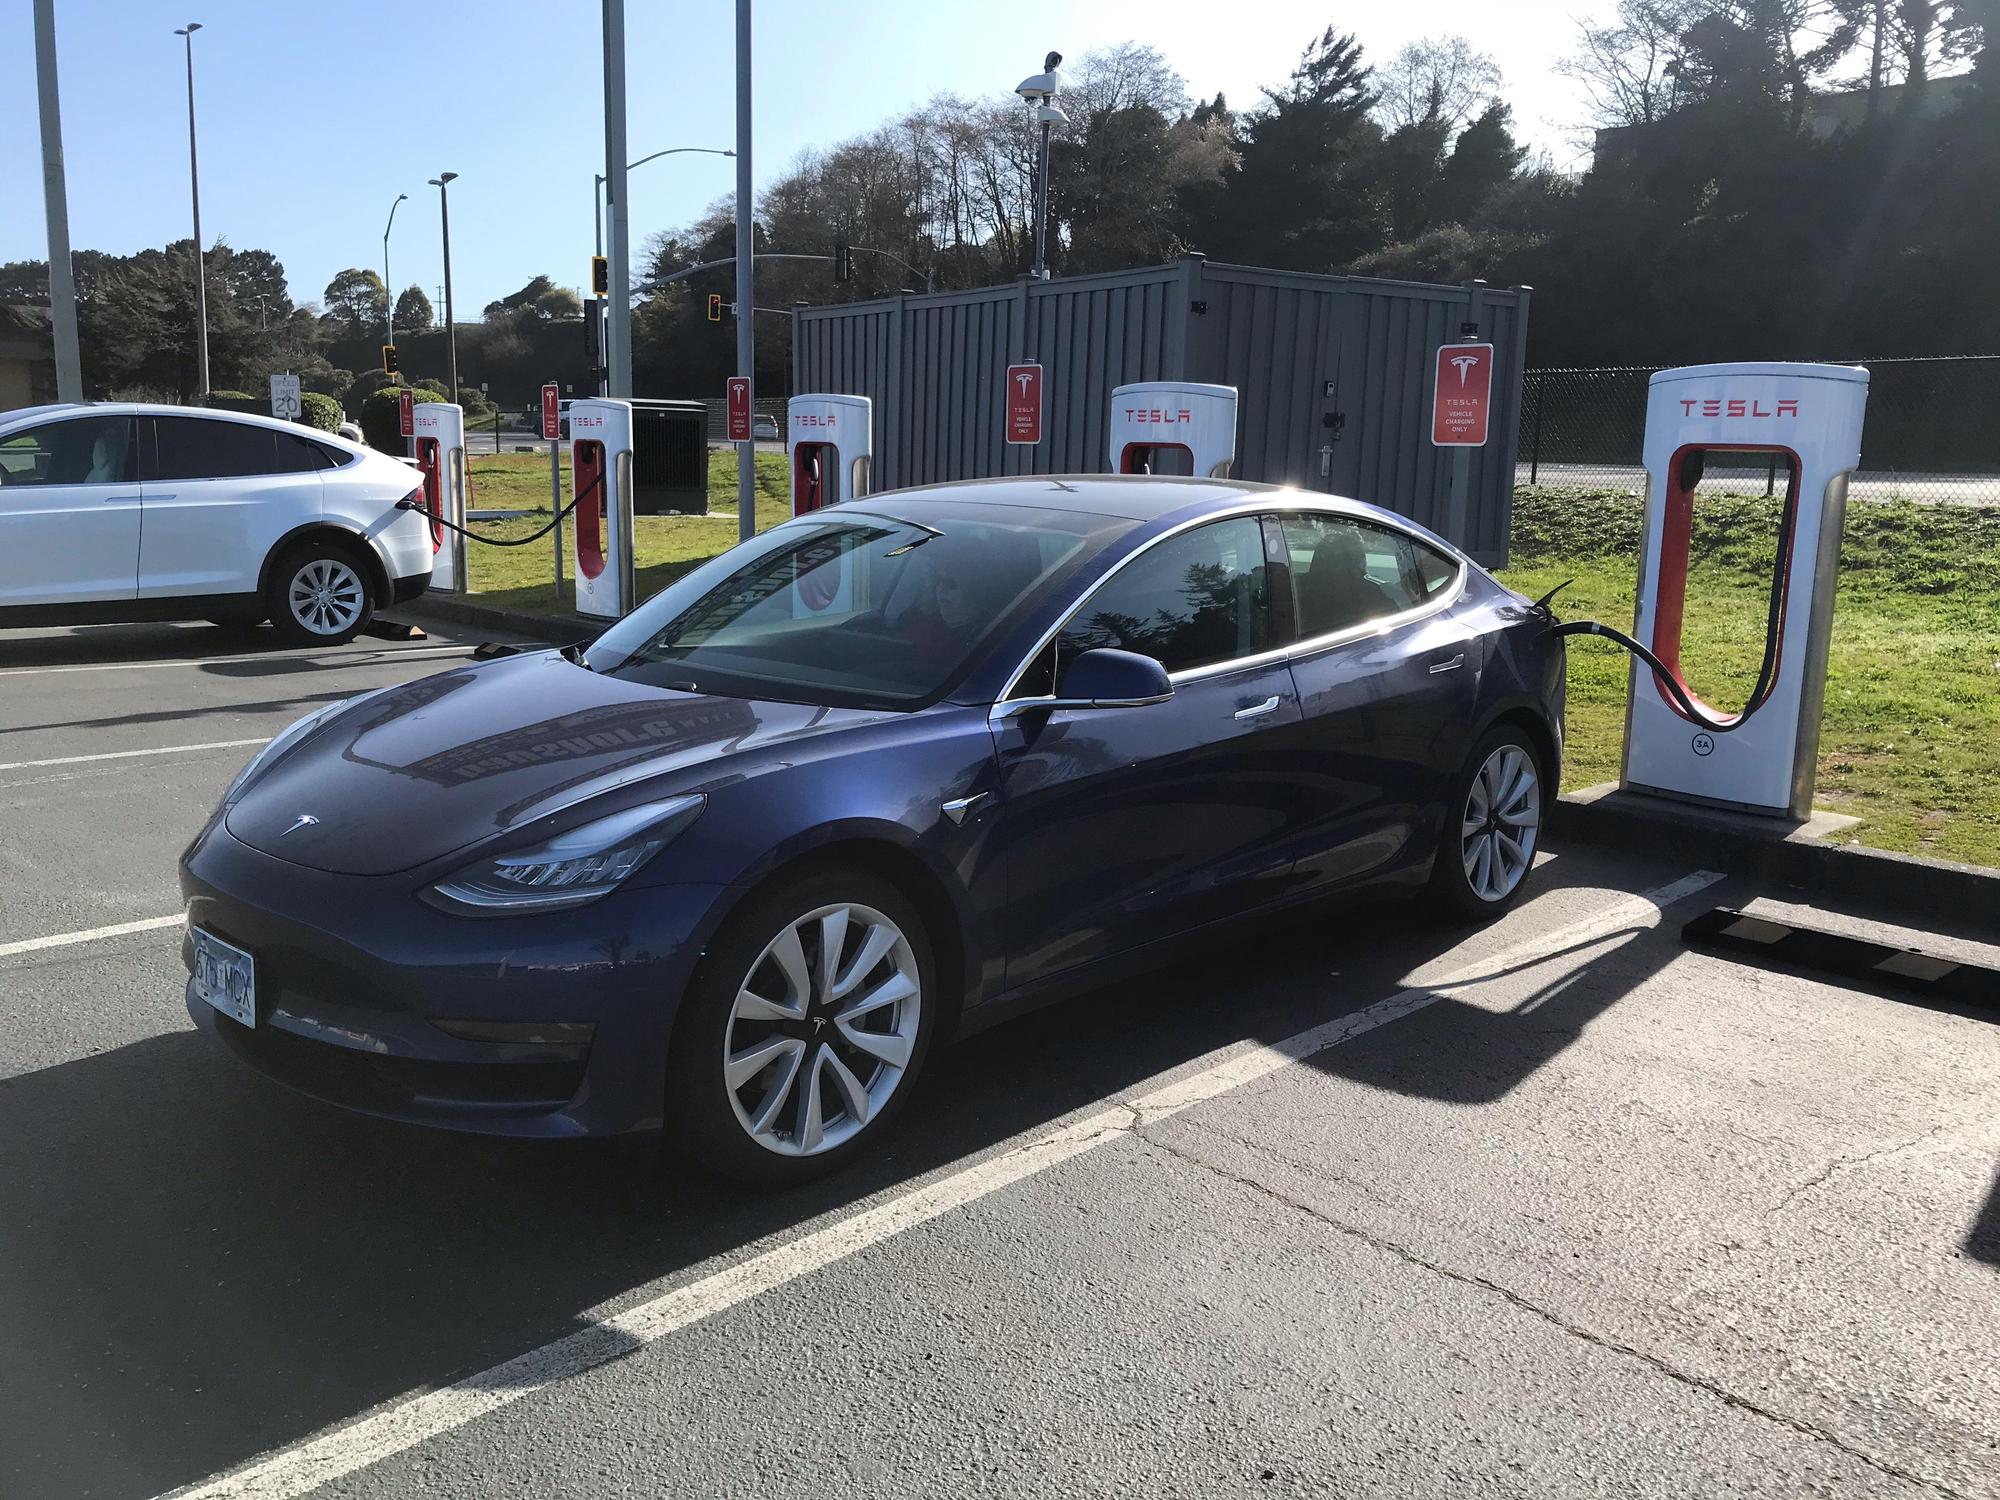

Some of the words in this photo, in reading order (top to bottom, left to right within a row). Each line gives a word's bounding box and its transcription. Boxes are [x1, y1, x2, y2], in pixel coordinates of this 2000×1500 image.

[275, 397, 298, 413] 20
[1679, 399, 1799, 417] TESLA
[415, 418, 438, 426] TESLA
[573, 417, 603, 427] TESLA
[794, 415, 836, 427] TESLA
[1125, 410, 1191, 423] TESLA
[1696, 740, 1710, 749] 3A
[224, 962, 251, 1010] MCX
